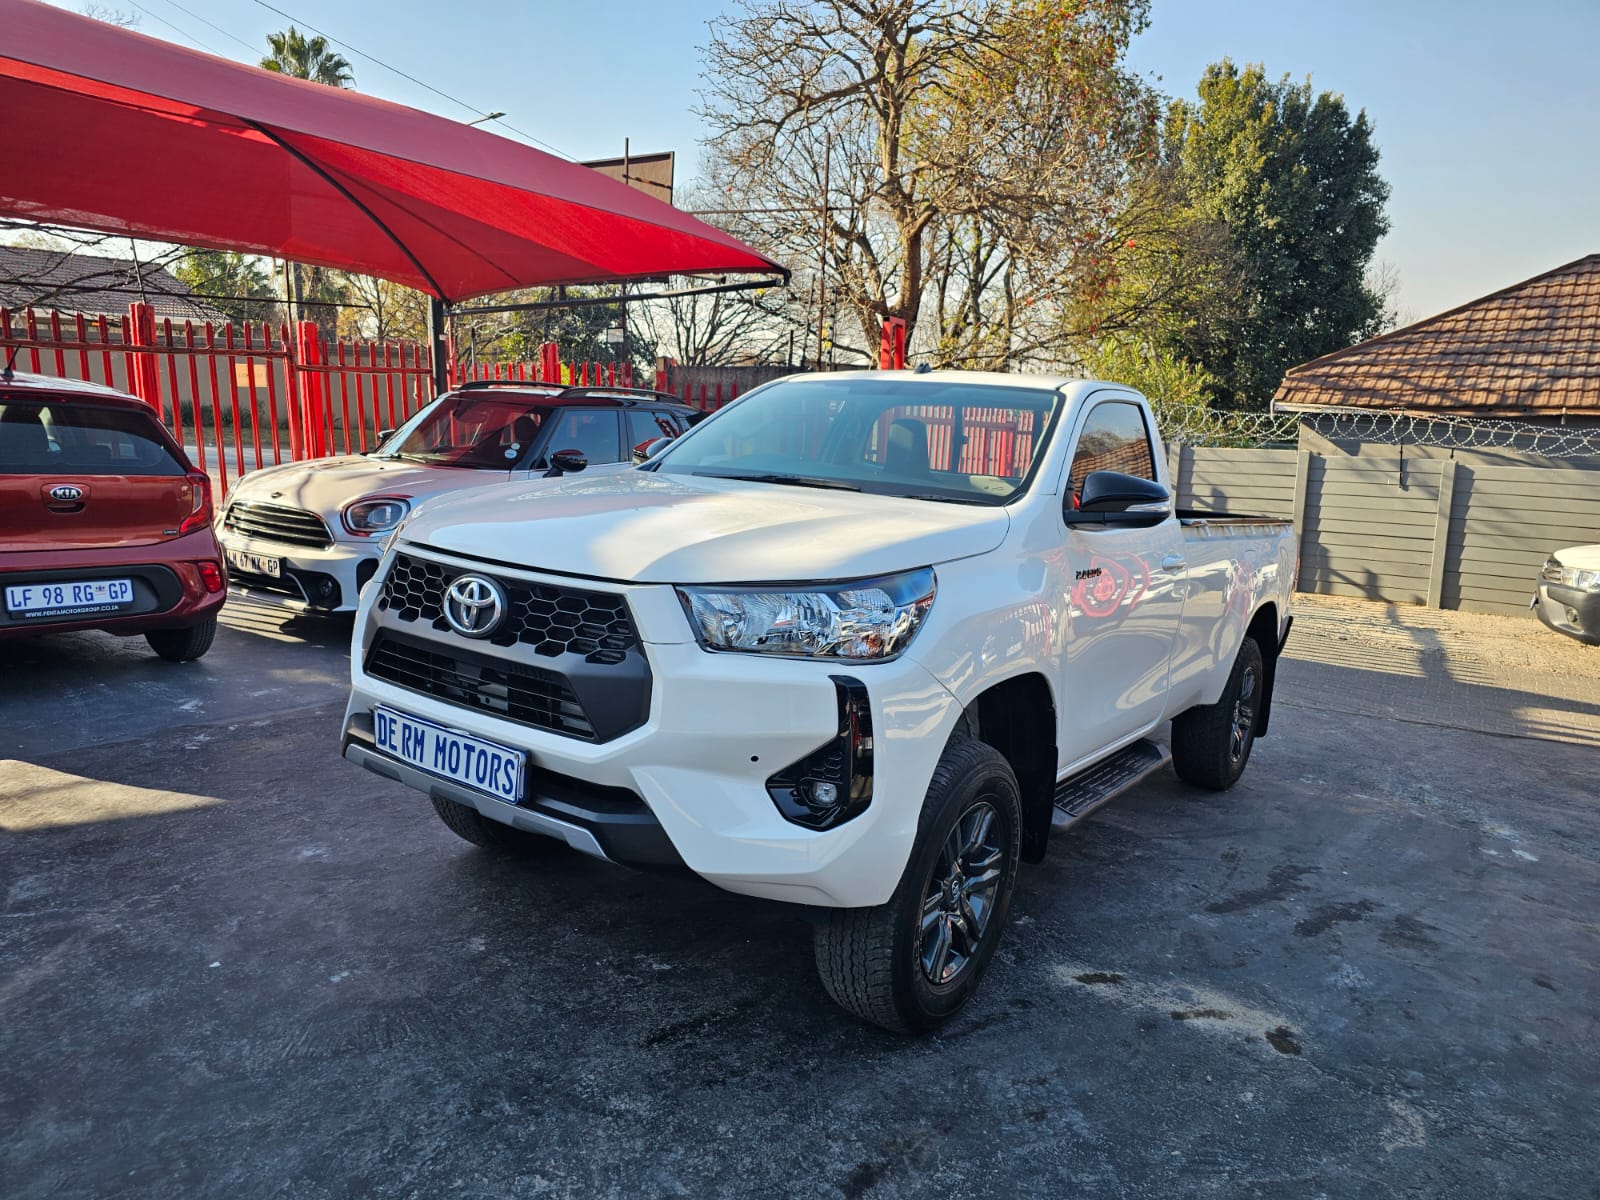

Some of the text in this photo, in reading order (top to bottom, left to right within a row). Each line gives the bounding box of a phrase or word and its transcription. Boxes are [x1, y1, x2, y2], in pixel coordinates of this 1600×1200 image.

[56, 489, 78, 499] KIA
[267, 559, 278, 575] GP
[10, 582, 128, 608] LF 98 RG GP
[433, 734, 516, 795] MOTORS
